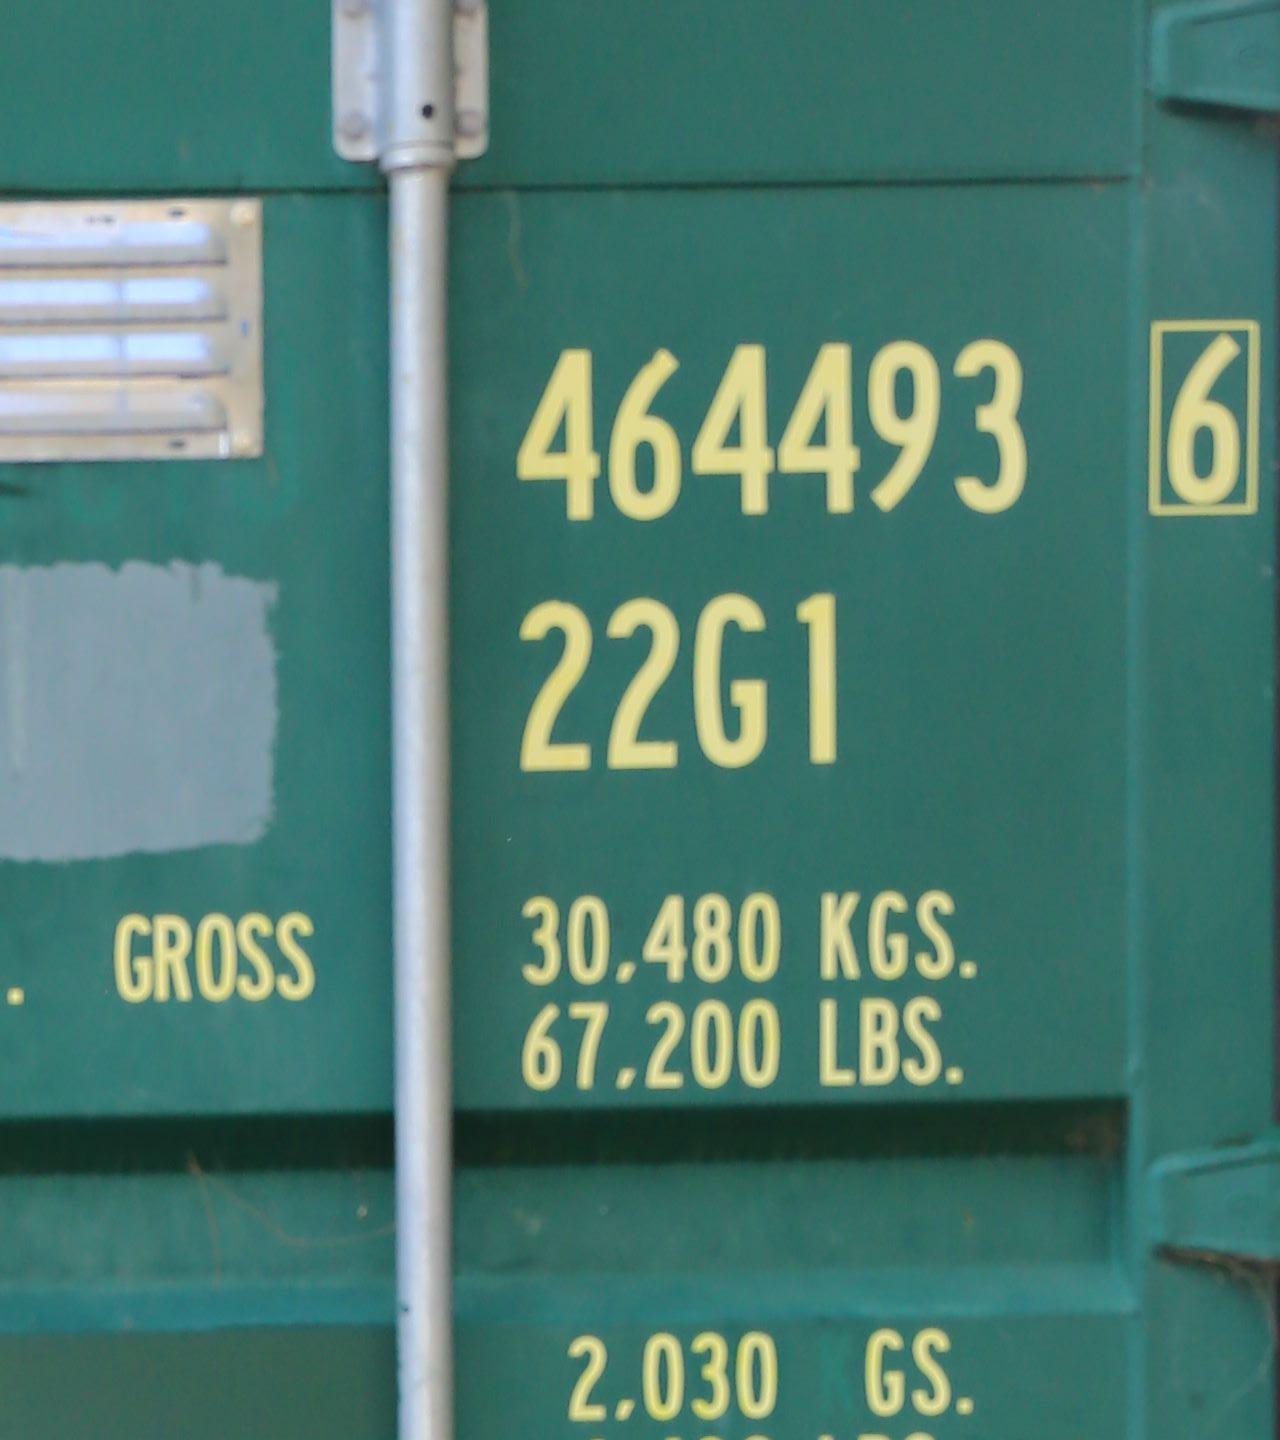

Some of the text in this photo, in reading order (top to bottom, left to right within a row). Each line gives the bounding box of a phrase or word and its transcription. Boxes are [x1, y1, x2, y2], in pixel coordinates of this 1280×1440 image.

[517, 333, 1240, 521] 464493 6
[520, 593, 836, 772] 22G1
[114, 912, 315, 1003] GROSS
[820, 890, 976, 980] KGS.
[820, 996, 963, 1086] LBS.
